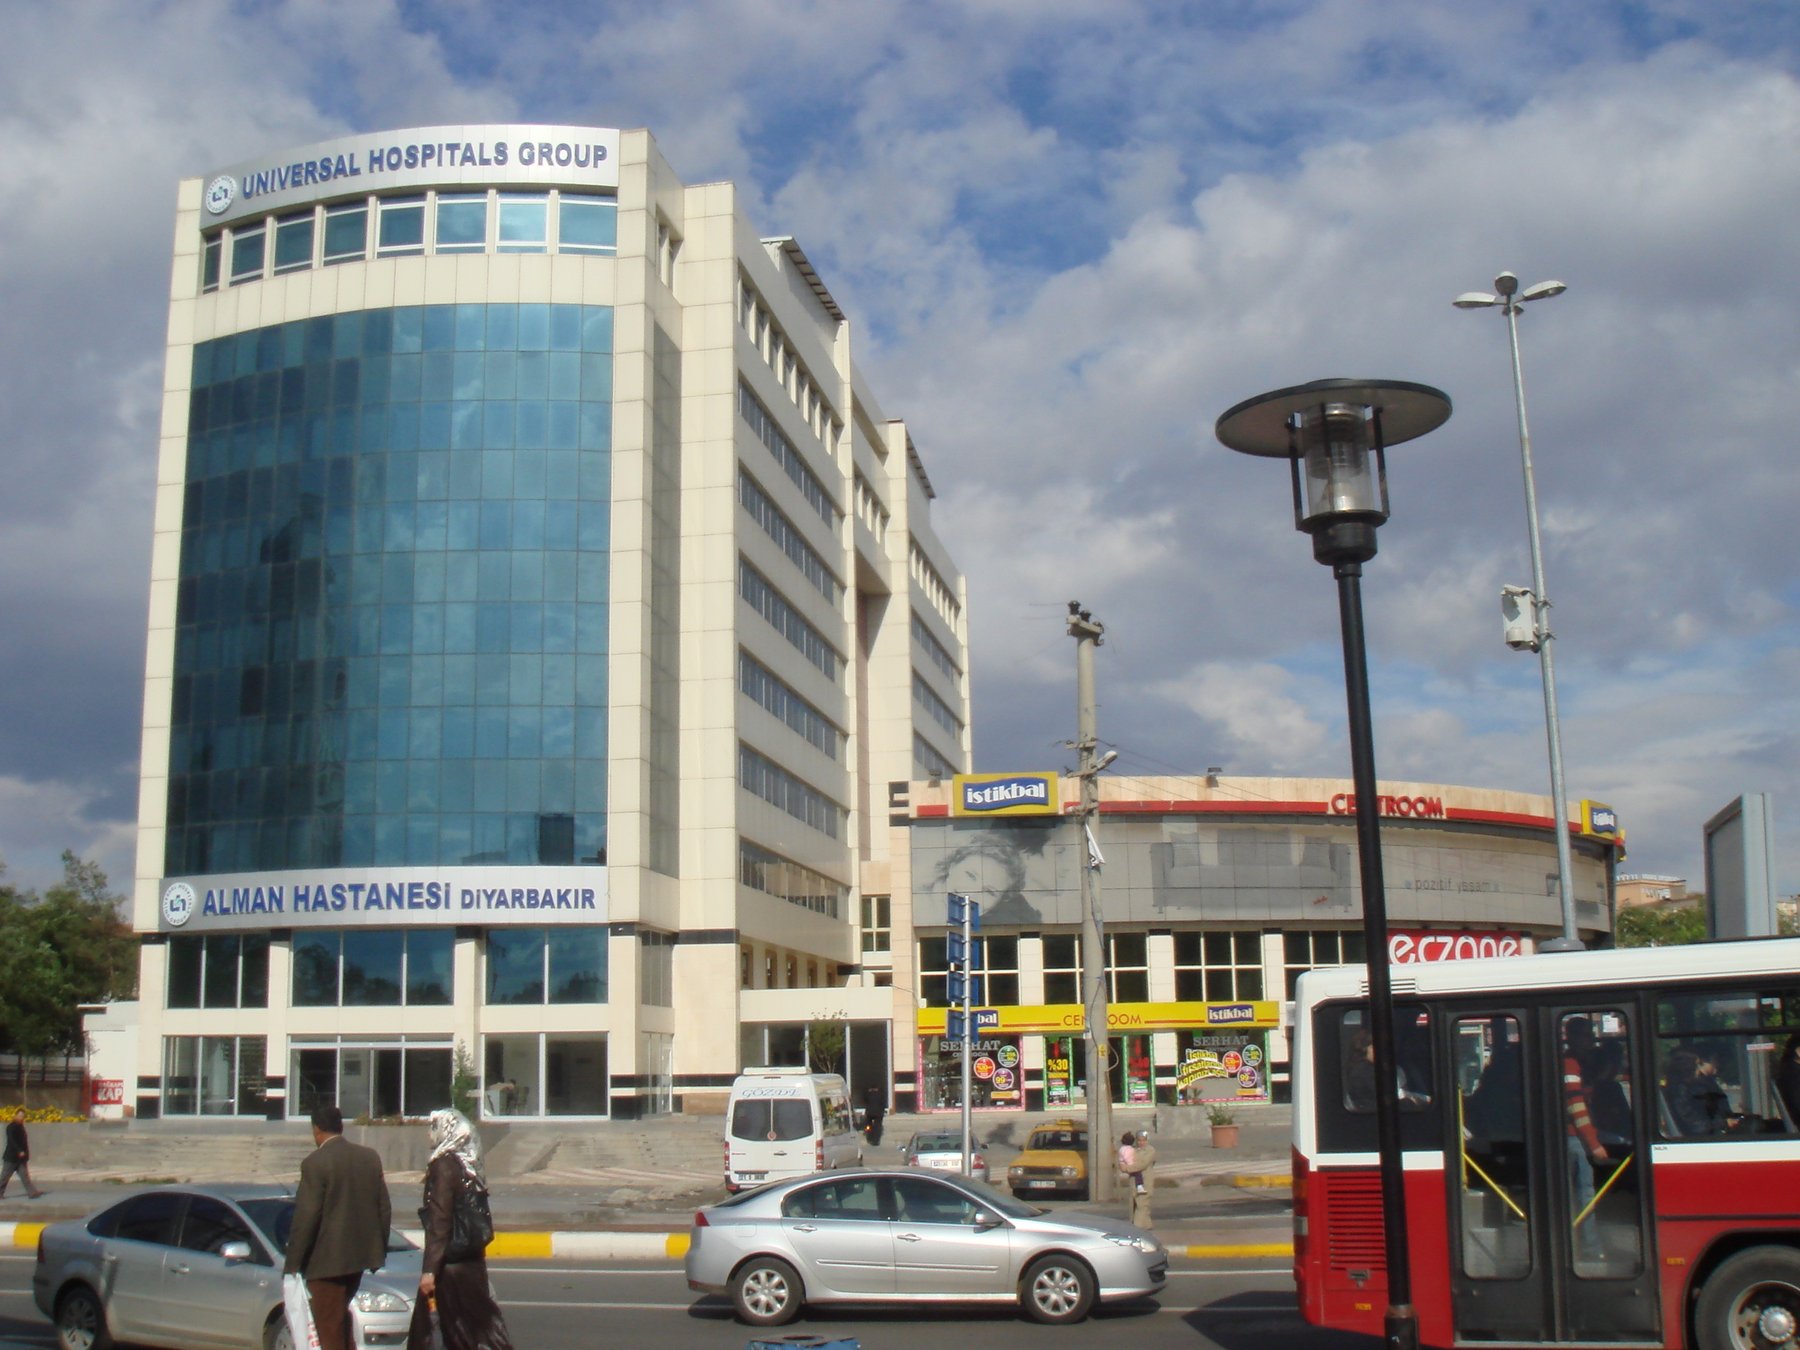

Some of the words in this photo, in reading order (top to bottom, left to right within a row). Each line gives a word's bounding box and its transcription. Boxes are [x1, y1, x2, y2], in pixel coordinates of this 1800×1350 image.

[242, 153, 361, 200] UNIVERSAL
[369, 142, 508, 173] HOSPITALS
[518, 142, 608, 168] GROUP
[967, 783, 1045, 803] istikbal
[1331, 793, 1444, 817] CETROOM
[203, 886, 285, 916] ALMAN
[1063, 1014, 1142, 1027] CEOOM
[1209, 1007, 1253, 1020] istikbal
[1193, 1036, 1249, 1047] SERHAT
[1047, 1059, 1069, 1071] %30
